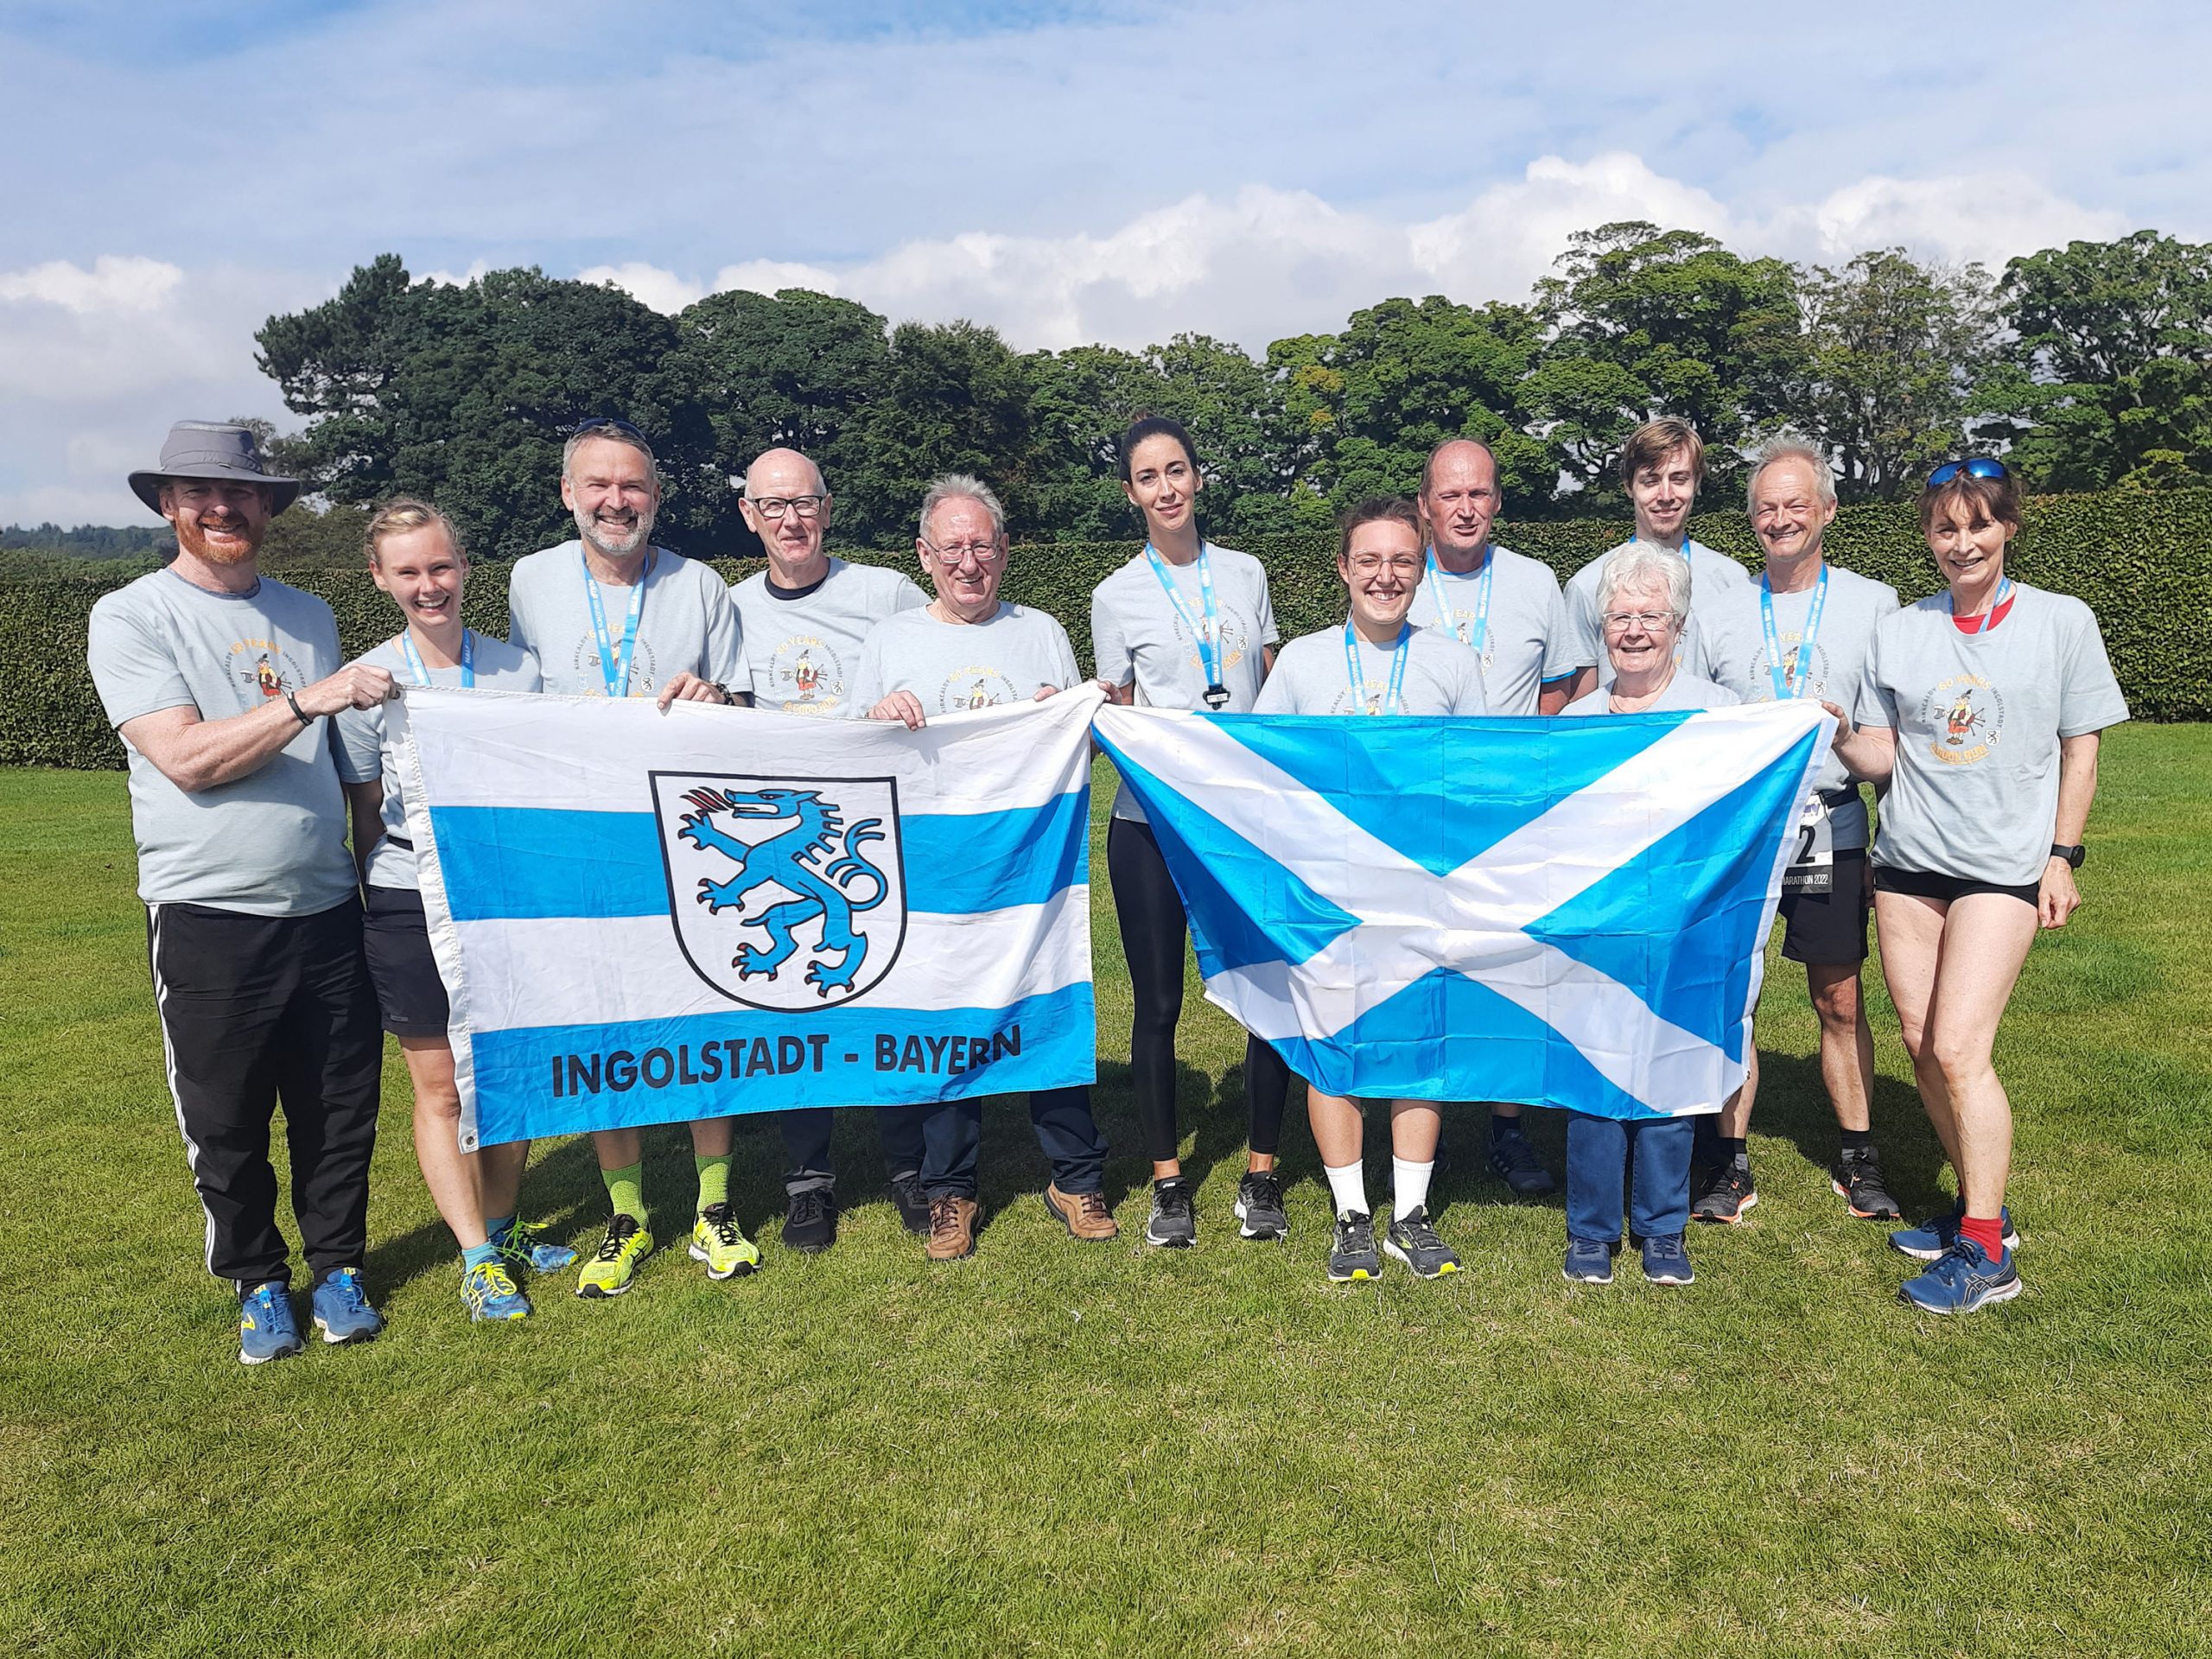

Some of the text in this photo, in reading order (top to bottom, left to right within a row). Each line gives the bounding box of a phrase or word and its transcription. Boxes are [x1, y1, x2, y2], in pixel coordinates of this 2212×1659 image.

[574, 635, 588, 671] KIRKCALDY
[641, 638, 656, 676] INGOLSTADT
[787, 635, 824, 649] YEARS
[768, 653, 777, 688] KIRKCALDY
[824, 644, 843, 678] INGOLSTADT
[1749, 646, 1764, 681] KIRKCALDY
[1815, 643, 1829, 679] INGOLSTADT
[939, 678, 950, 713] KIRKCALDY
[1001, 674, 1019, 702] INGOLSTA
[1921, 688, 1936, 723] KIRKCALDY
[1991, 686, 2005, 728] INGOLSTADT
[1814, 874, 1828, 885] 2022
[552, 1025, 1021, 1098] INGOLSTADT - BAYERN
